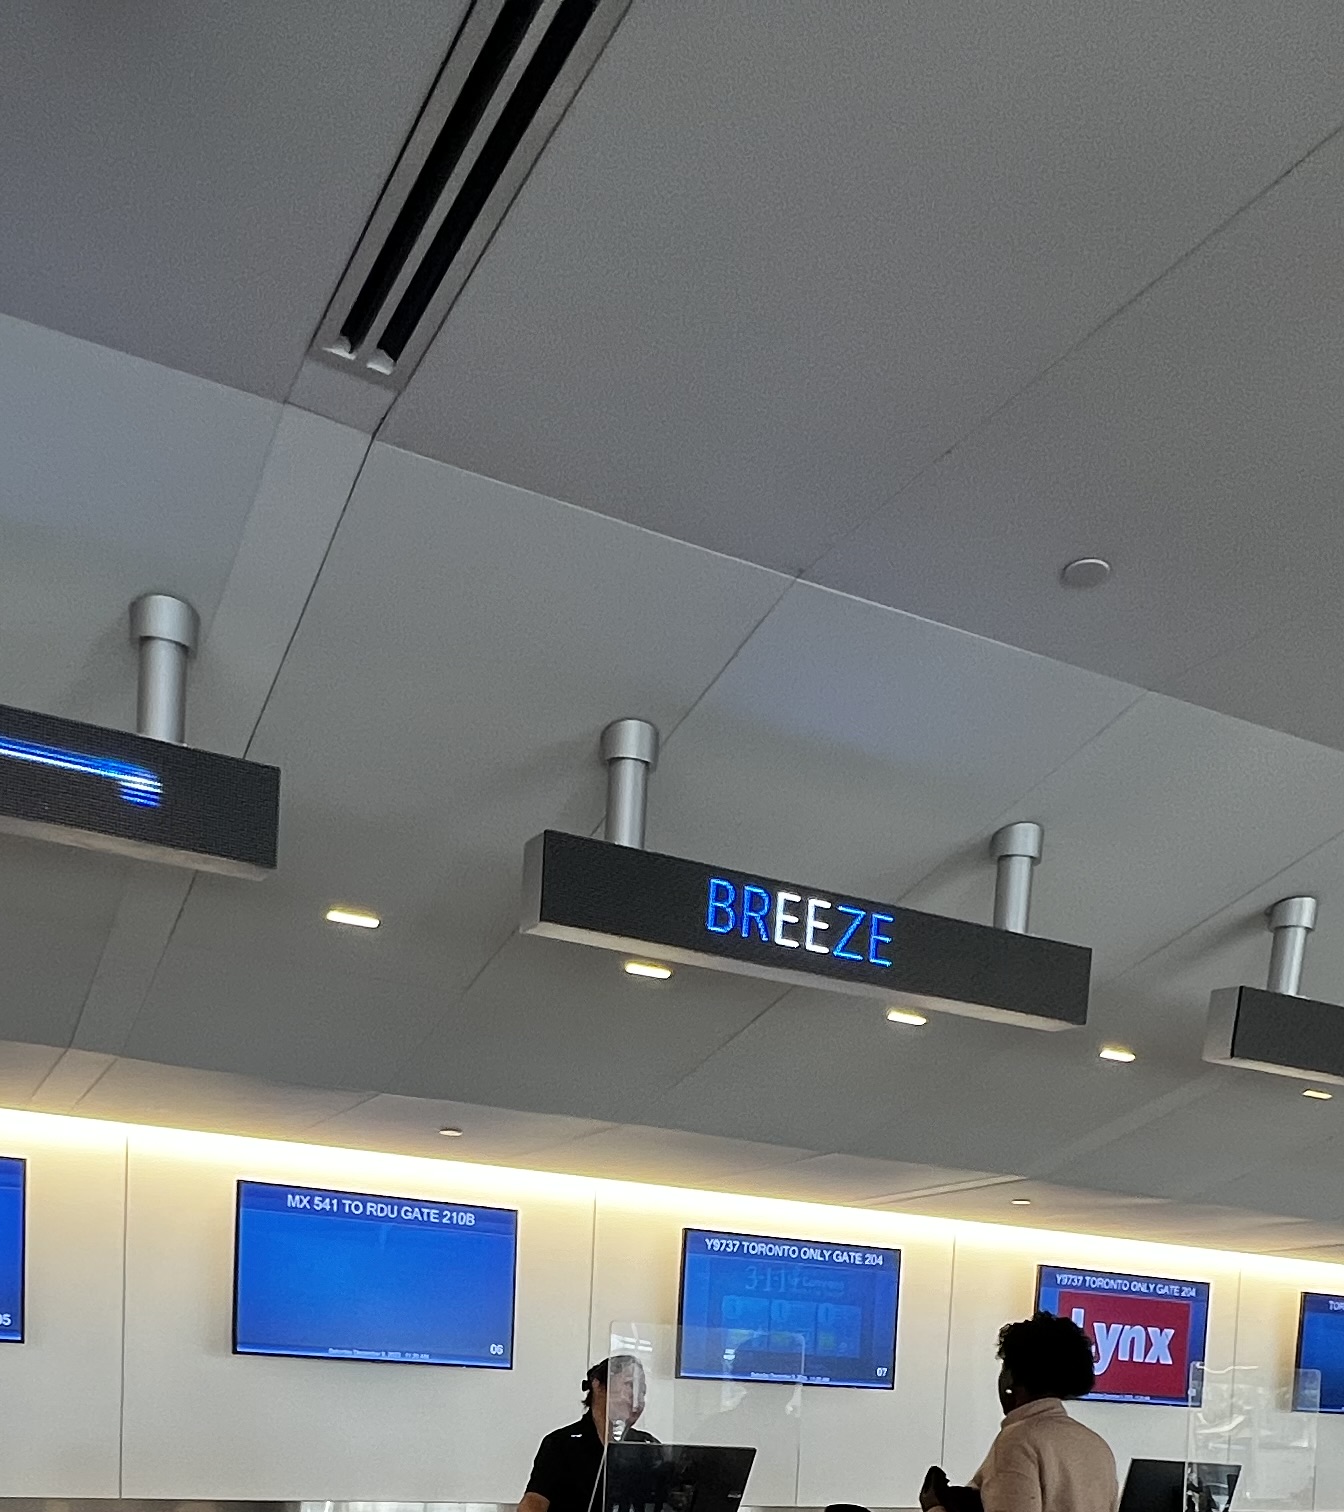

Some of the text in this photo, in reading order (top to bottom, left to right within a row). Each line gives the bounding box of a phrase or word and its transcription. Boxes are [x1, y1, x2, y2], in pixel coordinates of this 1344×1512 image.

[706, 876, 895, 968] BREEZE
[287, 1194, 476, 1226] MX 541 TO RDU GATE 210B
[704, 1238, 883, 1266] Y9737 TORONTO ONLY GATE 204
[1085, 1276, 1129, 1291] TORONTO
[1131, 1281, 1155, 1292] ONLY
[1156, 1284, 1180, 1295] GATE
[490, 1344, 504, 1355] 06
[877, 1367, 888, 1377] 07
